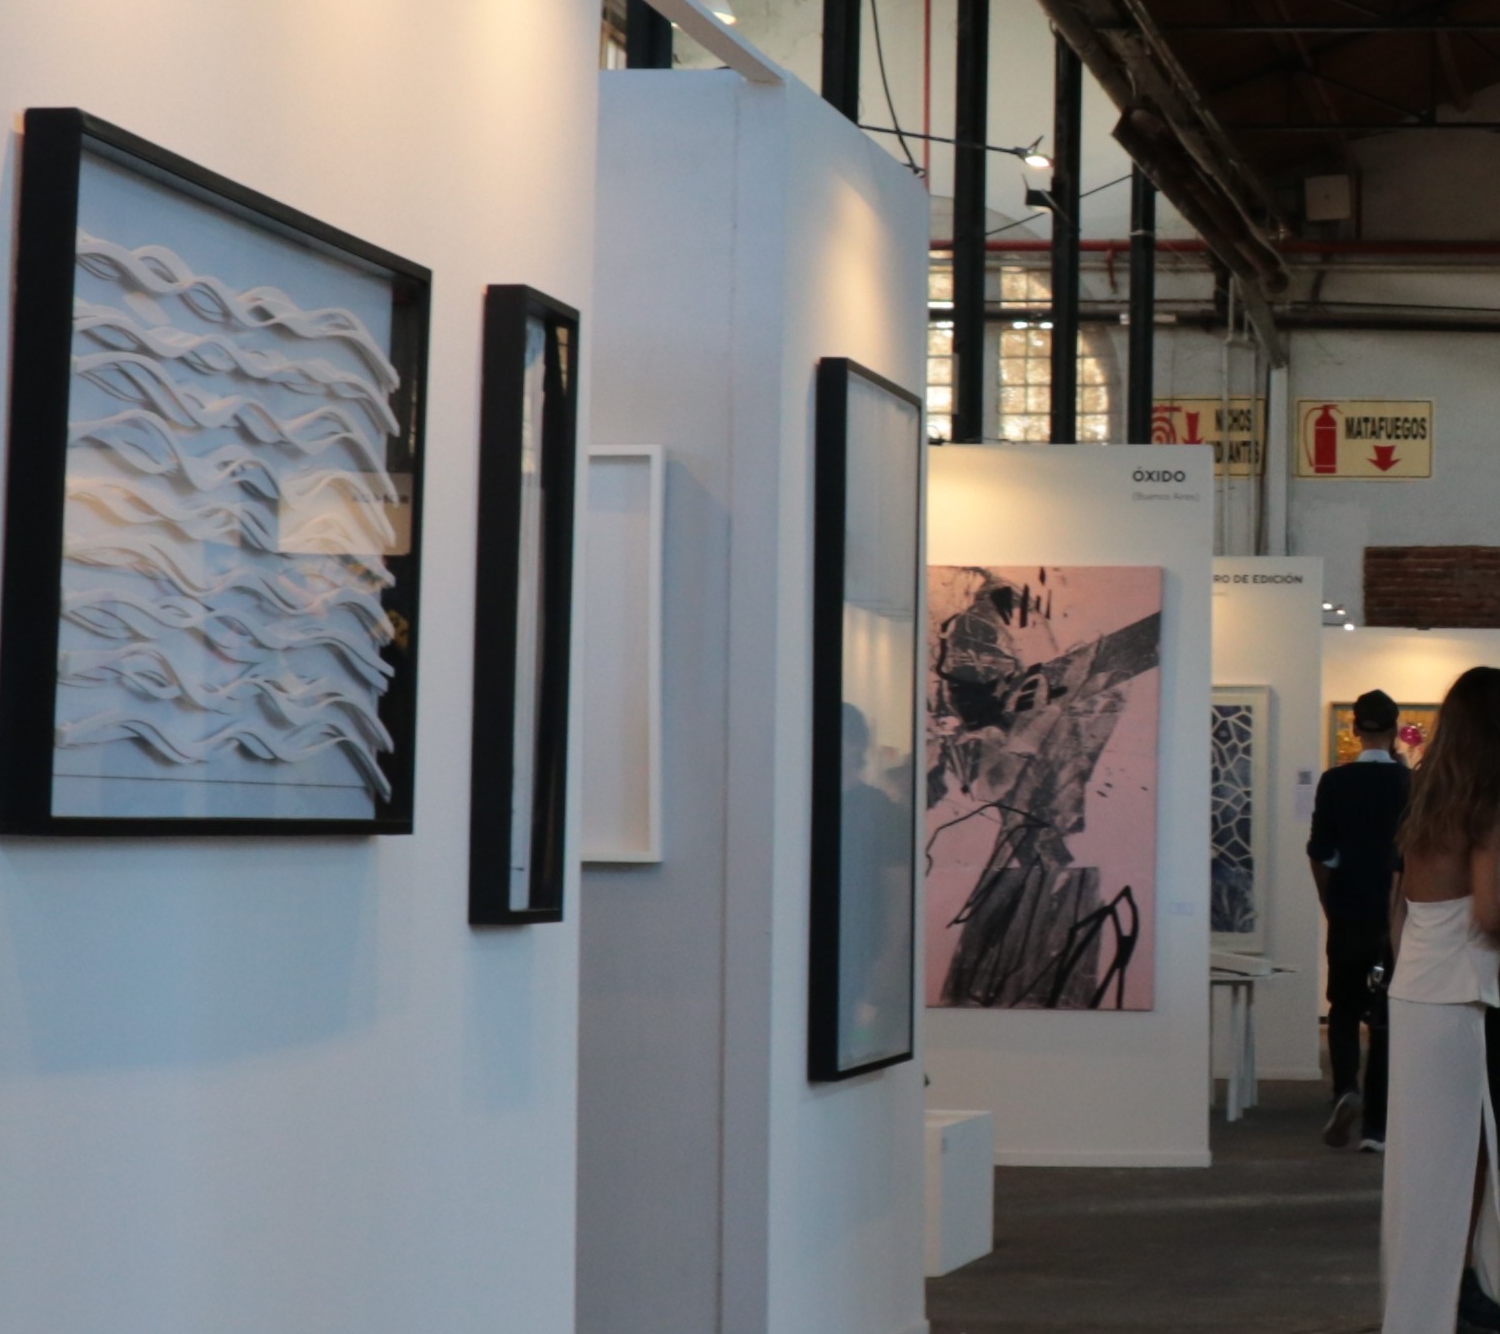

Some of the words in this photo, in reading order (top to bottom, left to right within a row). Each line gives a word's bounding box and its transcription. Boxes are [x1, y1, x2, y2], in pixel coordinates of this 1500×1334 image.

[1345, 417, 1428, 439] MATAFUEGOS
[1132, 466, 1186, 482] ÓXIDO
[1233, 574, 1249, 584] DE
[1252, 572, 1304, 584] EDICIÓN
